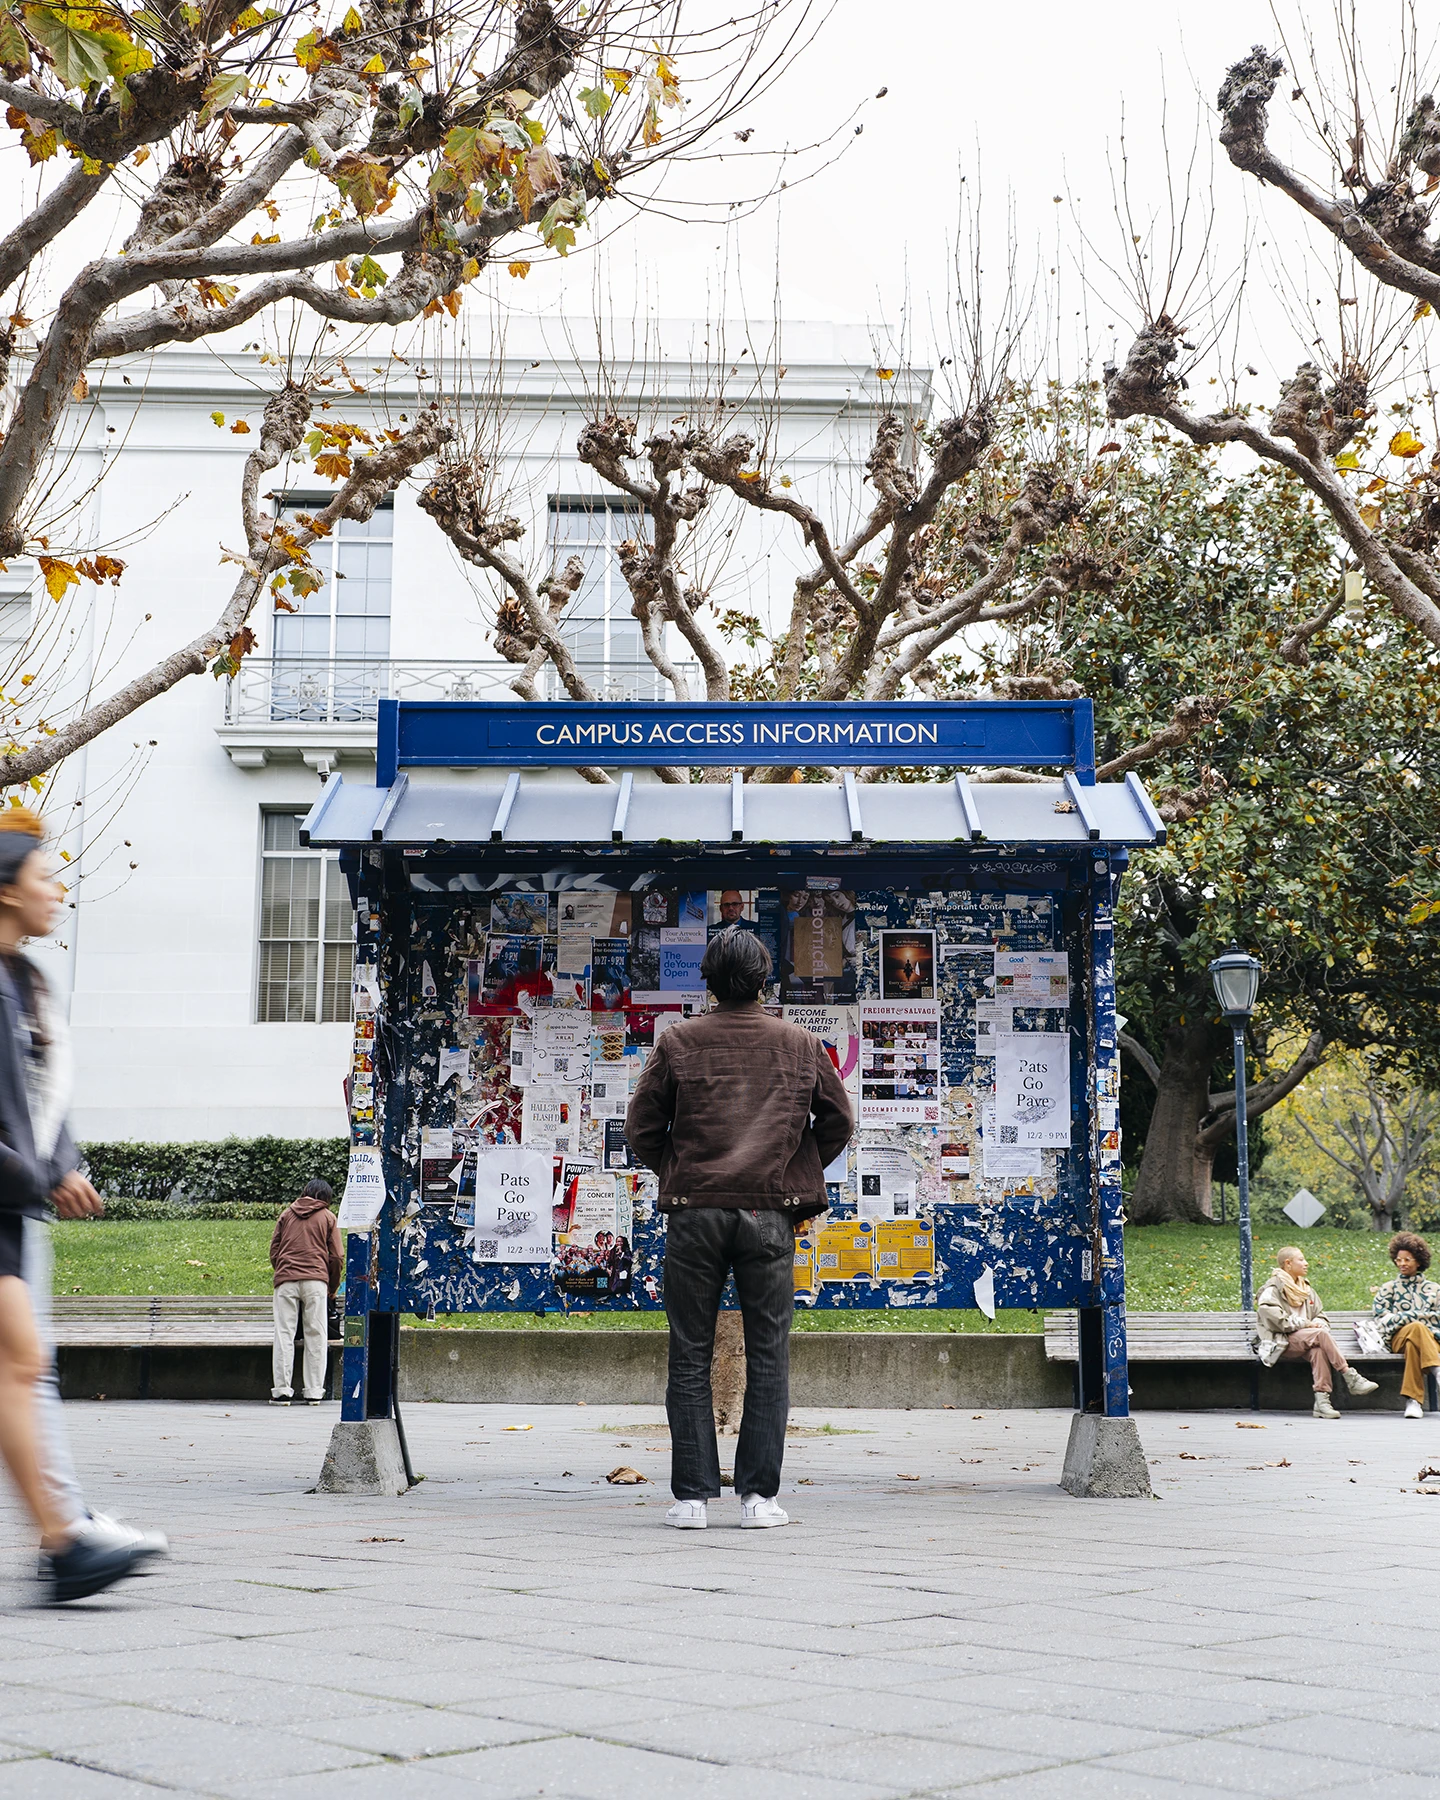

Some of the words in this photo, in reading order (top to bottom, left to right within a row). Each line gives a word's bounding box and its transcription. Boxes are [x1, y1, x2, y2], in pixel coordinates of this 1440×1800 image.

[536, 723, 643, 745] CAMPUS
[647, 723, 744, 745] ACCESS
[753, 723, 938, 745] INFORMATION
[855, 901, 889, 913] erkeley
[811, 909, 825, 987] BOTTICELLI
[508, 952, 519, 961] PM
[611, 955, 615, 965] 9
[615, 955, 625, 965] PM
[664, 951, 681, 960] The
[663, 968, 689, 979] Open
[788, 1008, 827, 1016] BECOME
[863, 1007, 895, 1015] FREIGHT
[895, 1007, 903, 1016] &
[903, 1007, 936, 1015] SALVAGE
[808, 1017, 839, 1025] ARTIST
[1018, 1059, 1048, 1073] Pats
[1023, 1076, 1044, 1090] Go
[1016, 1093, 1049, 1107] Pave
[530, 1103, 572, 1112] HALLOWN
[532, 1113, 554, 1122] FLASH
[1027, 1131, 1043, 1140] 12/2
[1049, 1131, 1054, 1140] 9
[1055, 1131, 1068, 1140] PM
[356, 1174, 380, 1184] DRIVE
[500, 1172, 530, 1187] Pats
[504, 1190, 525, 1204] Go
[496, 1207, 531, 1221] Pave
[507, 1245, 523, 1254] 12/2
[529, 1246, 535, 1254] 9
[535, 1246, 548, 1254] PM
